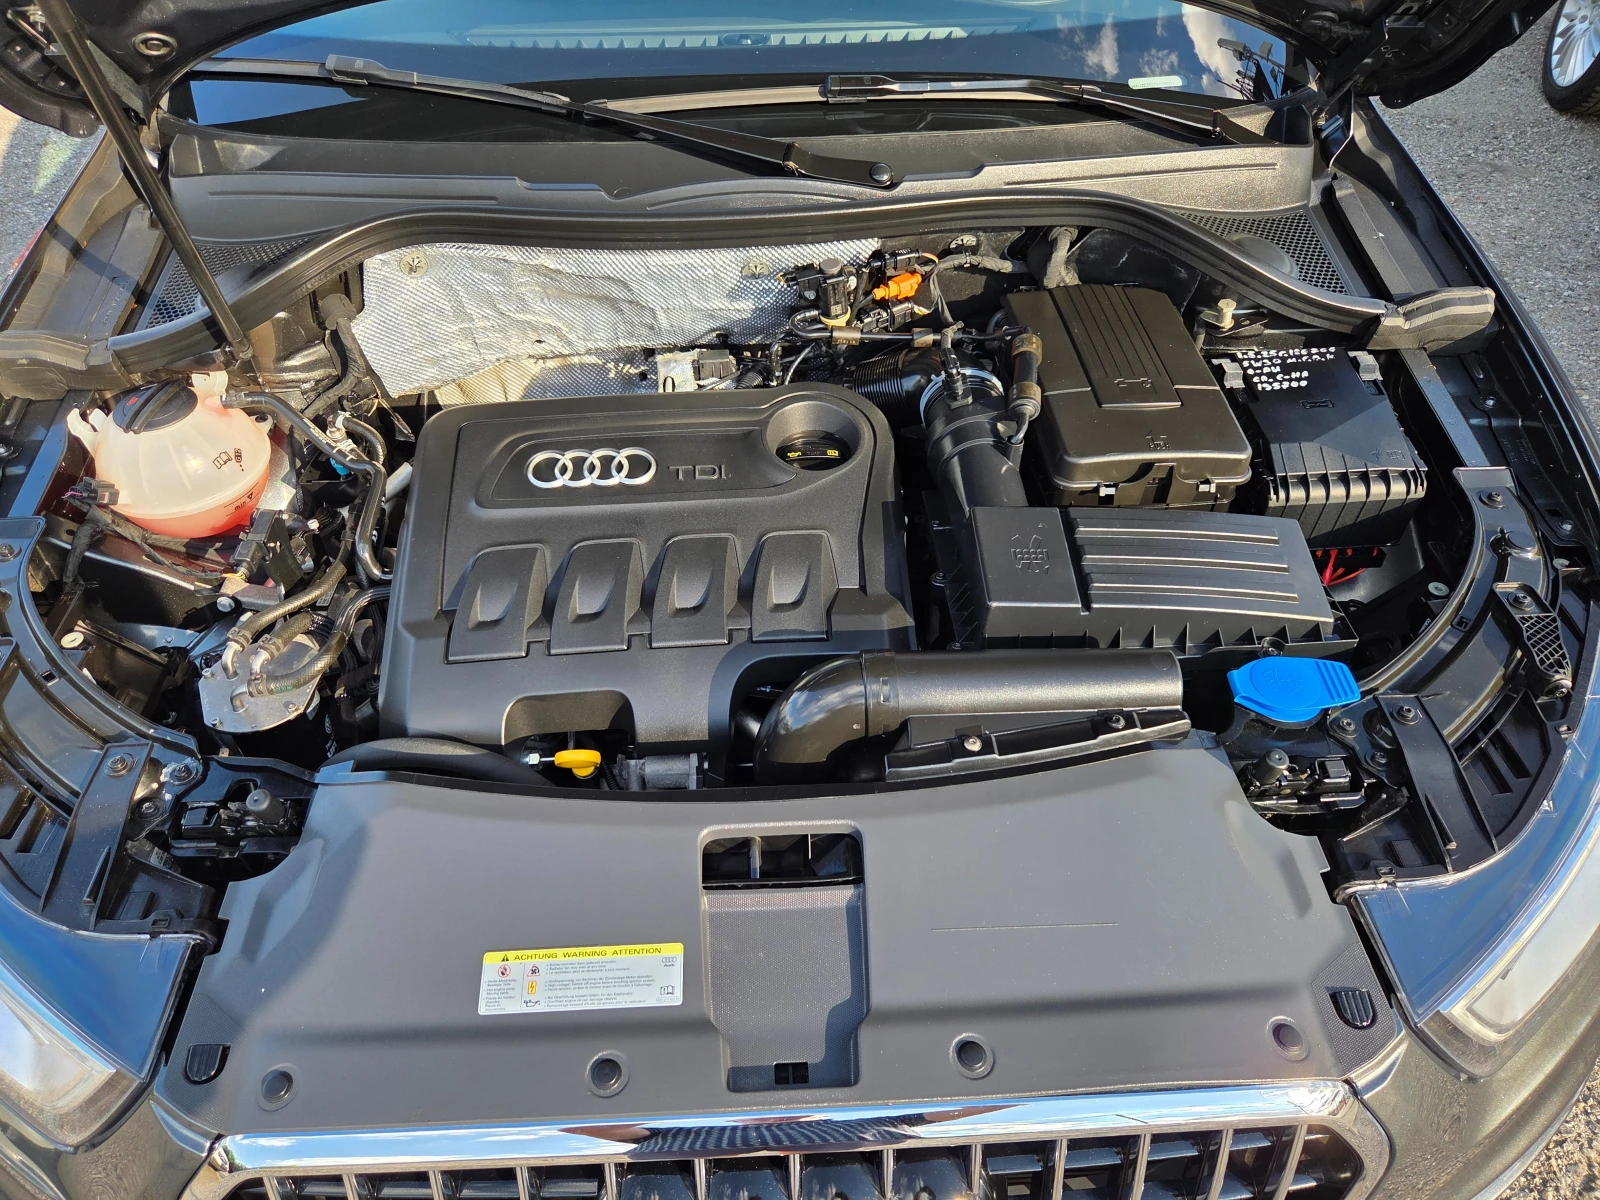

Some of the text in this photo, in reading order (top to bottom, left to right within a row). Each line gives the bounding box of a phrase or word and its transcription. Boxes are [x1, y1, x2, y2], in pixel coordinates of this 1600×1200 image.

[668, 464, 726, 480] TDI
[234, 500, 246, 511] min
[514, 947, 662, 961] ACHTUNG WARNING ATTENTION
